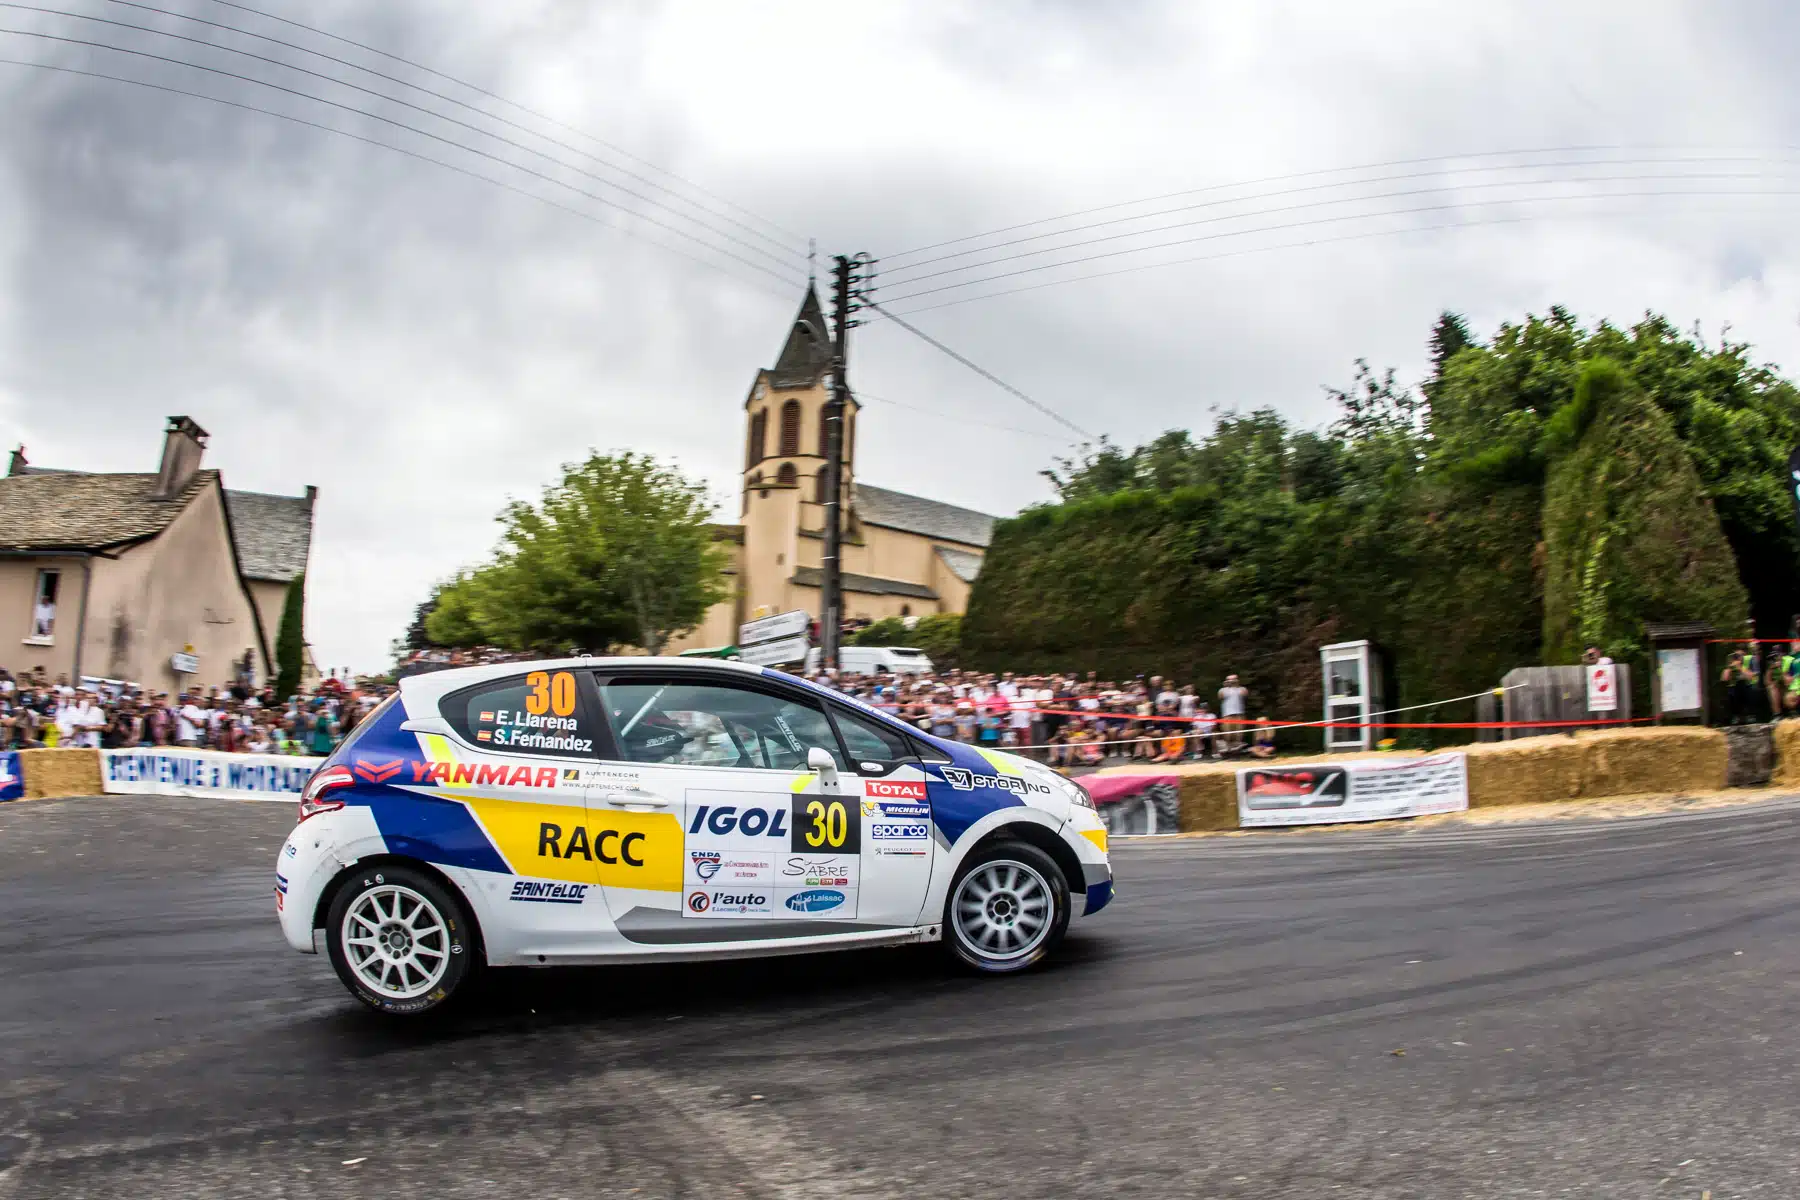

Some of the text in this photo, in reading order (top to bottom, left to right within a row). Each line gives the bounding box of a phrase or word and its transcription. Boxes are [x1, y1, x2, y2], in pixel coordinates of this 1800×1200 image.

[526, 671, 576, 717] 30
[411, 760, 559, 788] YANMAR
[867, 782, 924, 796] TOTAL
[886, 806, 930, 814] MICHELIN
[688, 805, 788, 837] IGOL
[805, 800, 848, 848] 30
[873, 825, 927, 839] sparco
[537, 822, 646, 867] RACC
[713, 892, 767, 905] l'auto
[812, 894, 843, 902] Laissac
